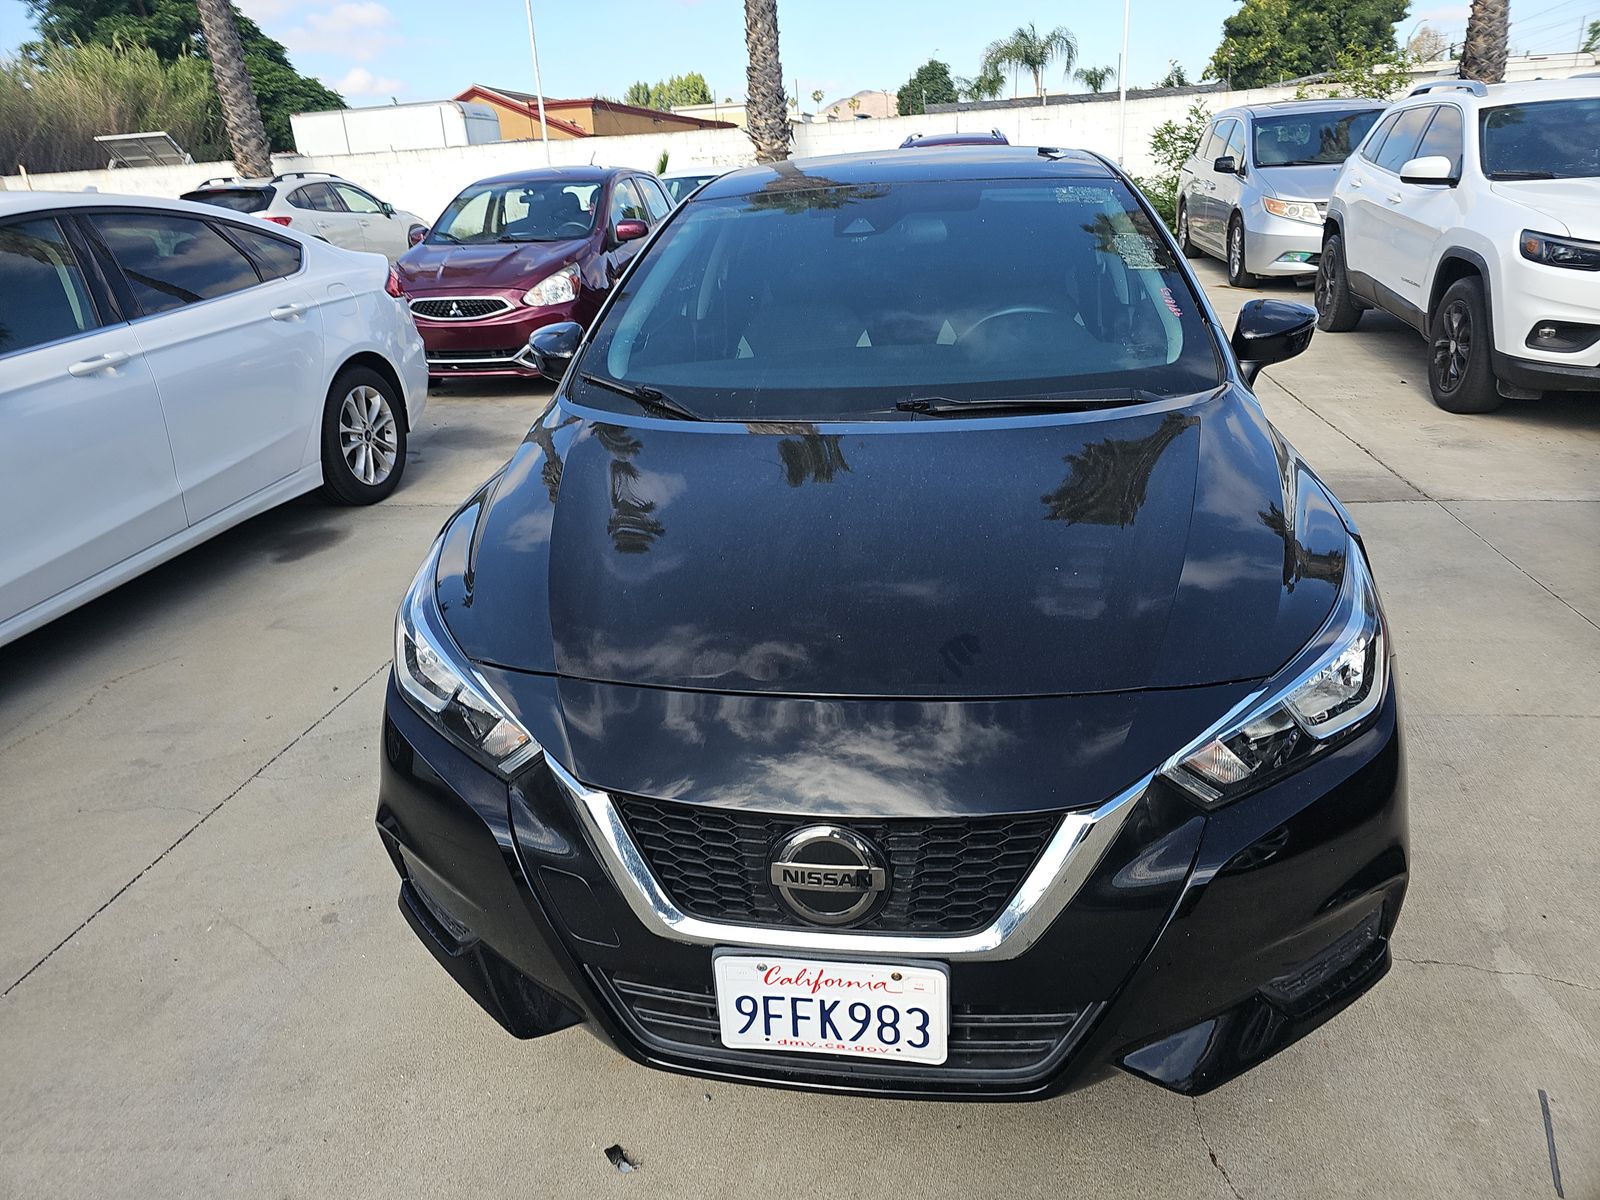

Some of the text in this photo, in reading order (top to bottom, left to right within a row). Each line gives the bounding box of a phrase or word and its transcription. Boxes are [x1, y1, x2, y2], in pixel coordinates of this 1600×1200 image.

[782, 869, 873, 888] NISSAN
[763, 965, 903, 994] California
[735, 995, 930, 1049] 9FFK983
[777, 1038, 889, 1054] dmv.ca.gov
